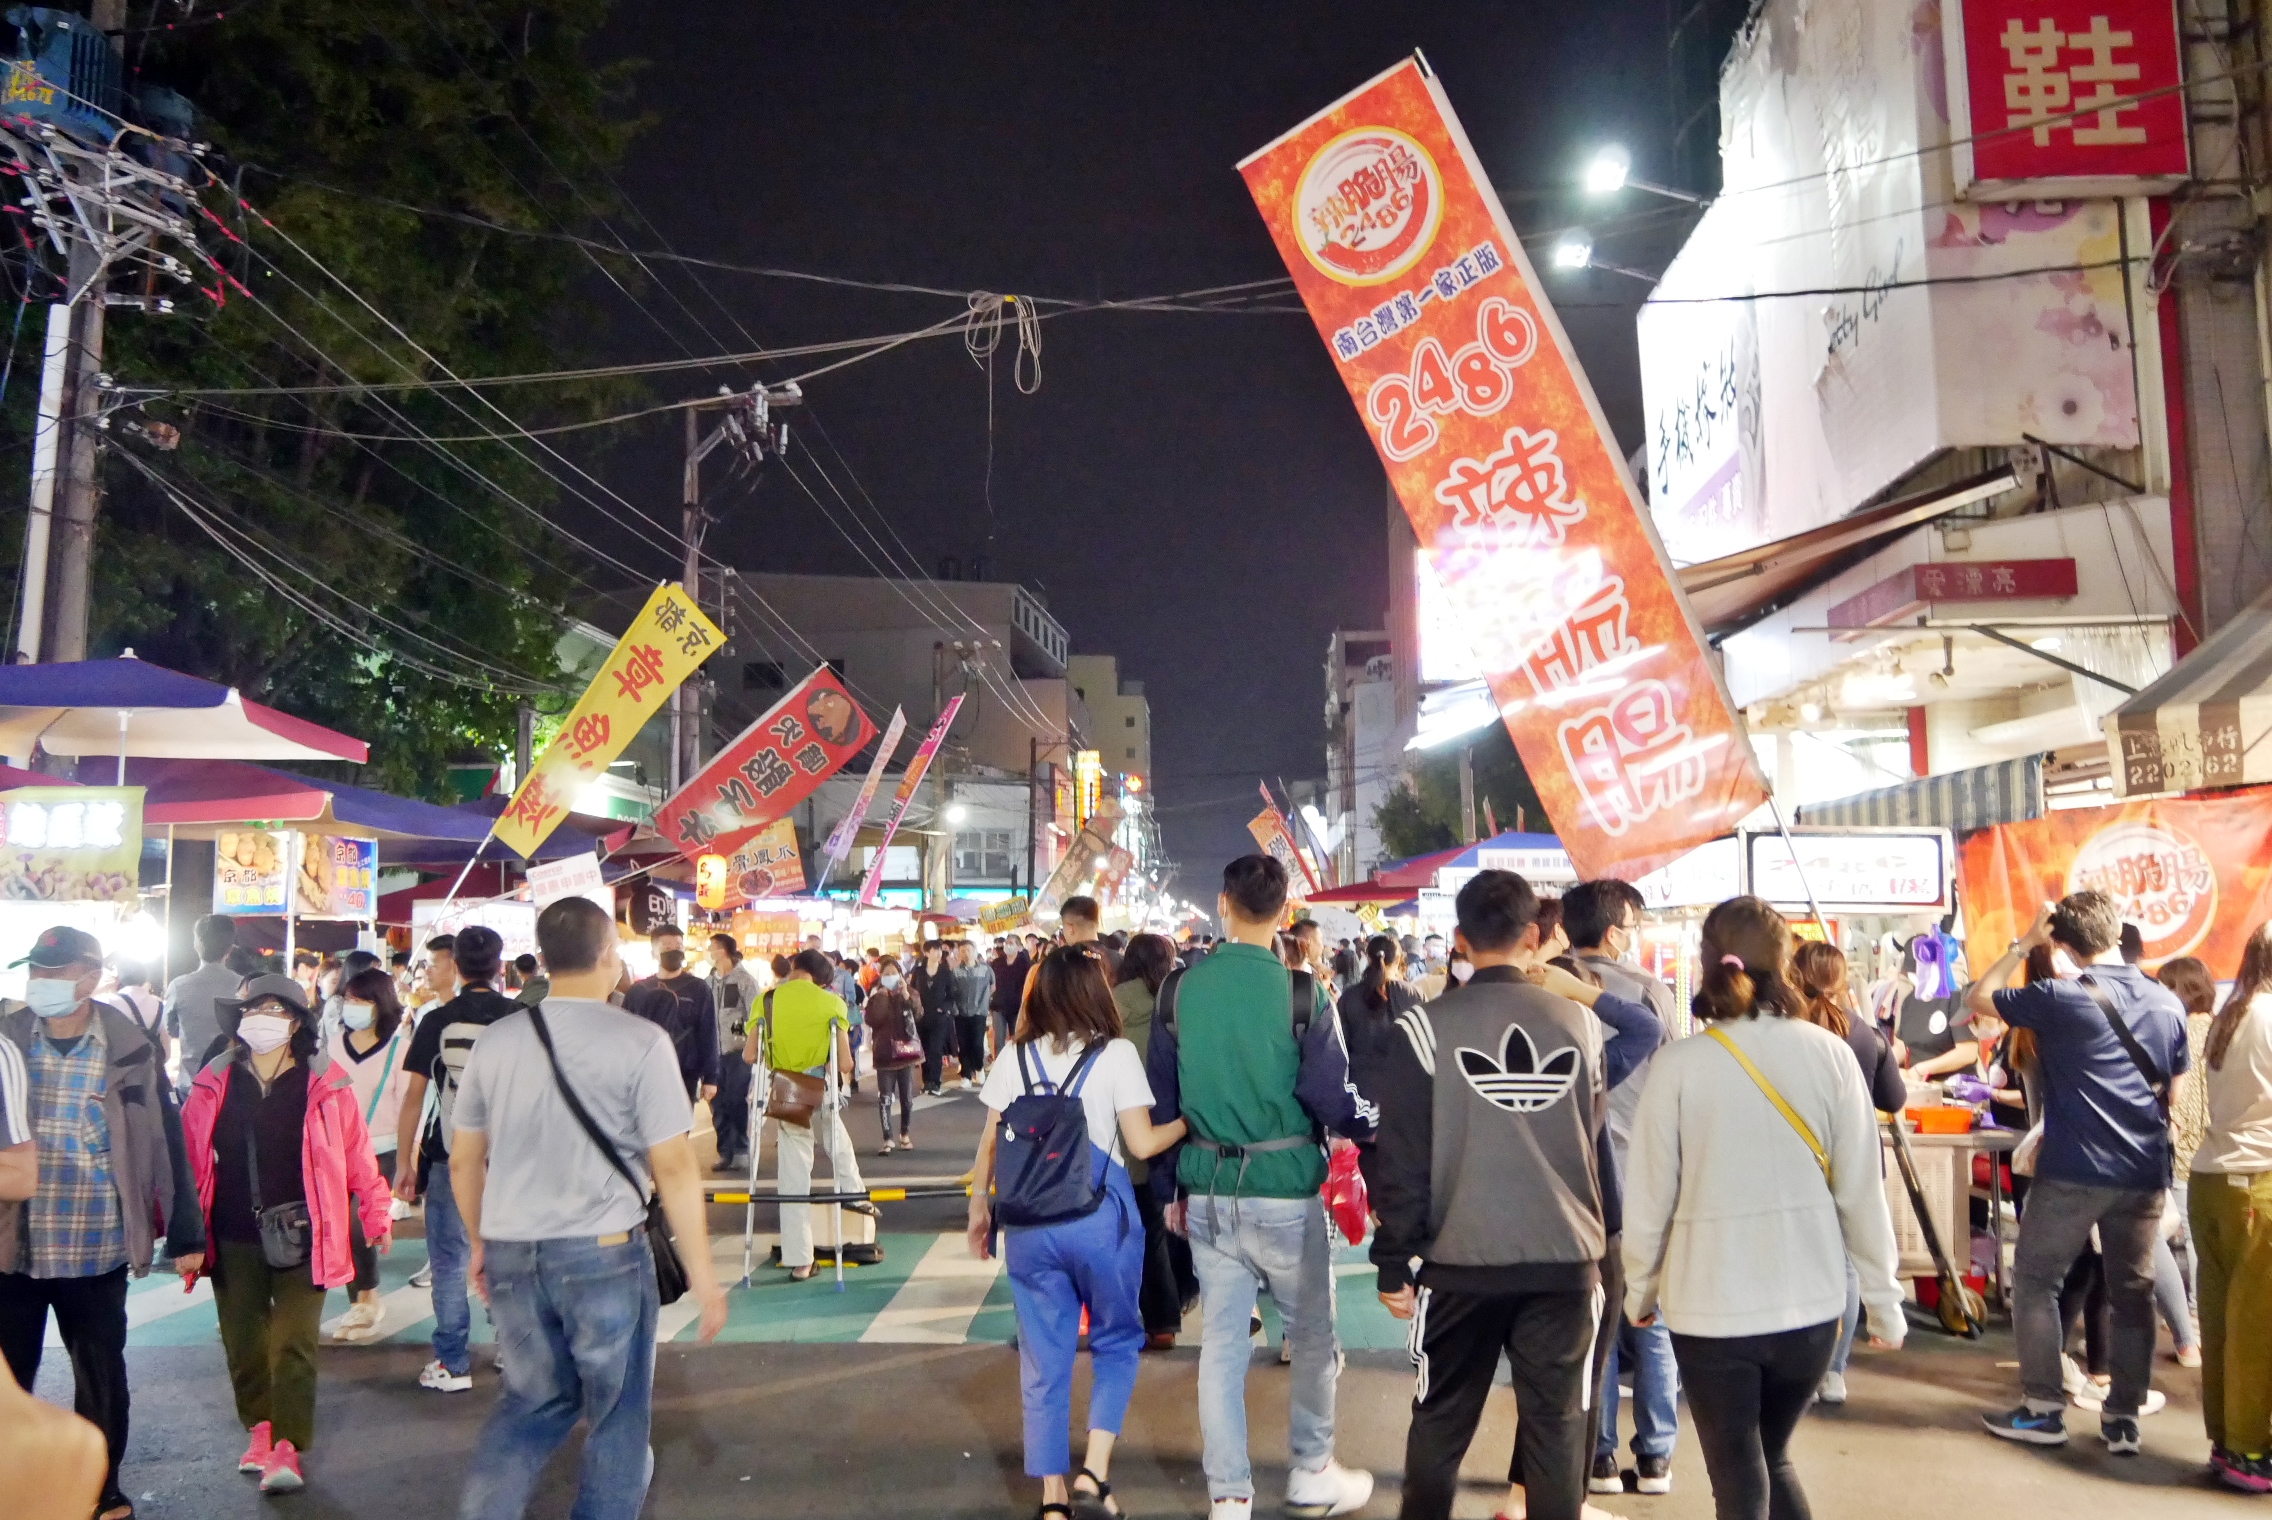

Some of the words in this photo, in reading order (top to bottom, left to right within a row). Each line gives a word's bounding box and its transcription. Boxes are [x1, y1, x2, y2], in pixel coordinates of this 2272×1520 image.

[2000, 15, 2147, 147] 鞋
[1338, 186, 1414, 248] 2486
[1335, 243, 1502, 360] 南台灣第一家正版
[1367, 298, 1536, 462] 2486
[727, 844, 798, 877] 骨鳳爪
